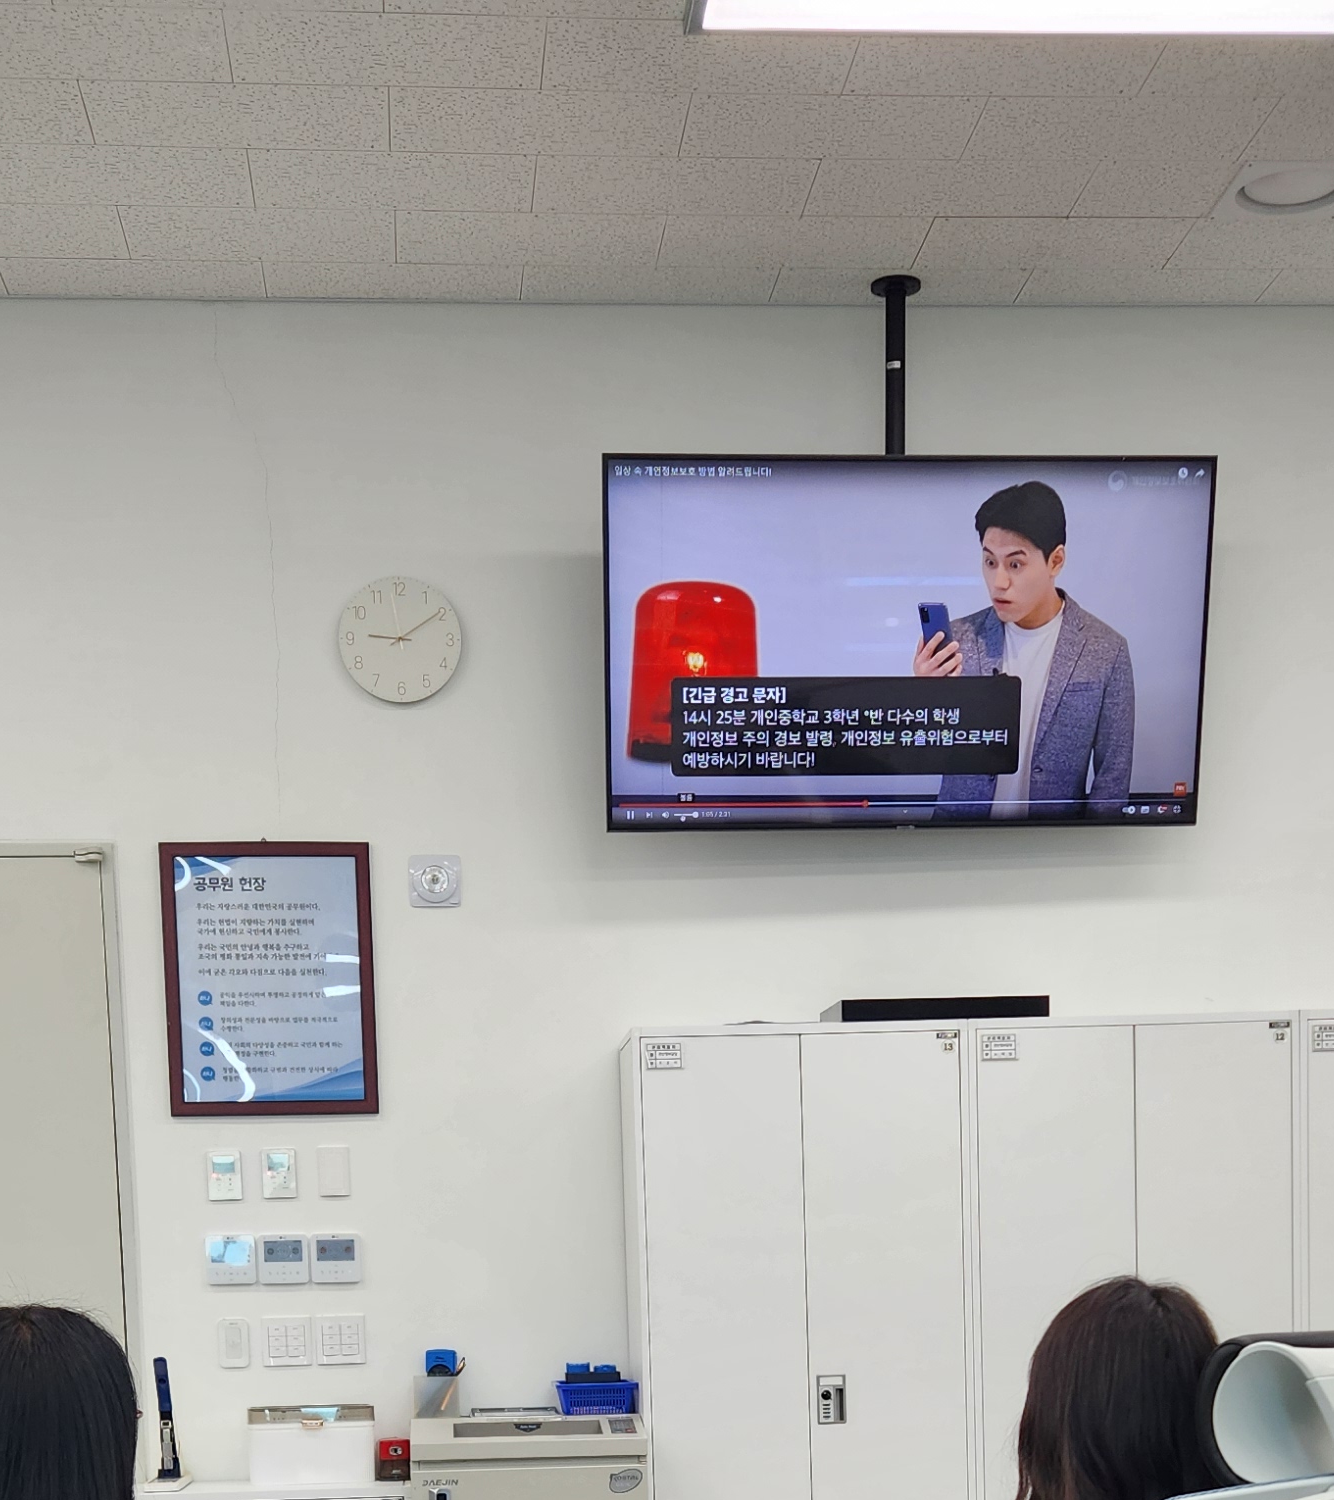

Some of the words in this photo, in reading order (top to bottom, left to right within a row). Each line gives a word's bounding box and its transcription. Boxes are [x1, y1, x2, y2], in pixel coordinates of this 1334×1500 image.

[644, 466, 696, 477] 개인정보보호
[392, 582, 407, 597] 12
[370, 590, 383, 604] 11
[422, 590, 429, 605] 1
[352, 605, 366, 620] 10
[438, 607, 447, 621] 2
[345, 631, 355, 646] 9
[445, 633, 455, 647] 3
[354, 656, 364, 670] 8
[439, 657, 448, 670] 4
[372, 673, 380, 687] 7
[422, 674, 431, 688] 5
[397, 682, 407, 696] 6
[682, 687, 717, 704] [긴급
[720, 687, 749, 703] 경고
[752, 687, 787, 703] 문자]
[683, 710, 712, 725] 14시
[716, 709, 745, 725] 25분
[750, 709, 820, 725] 개인중학교
[823, 709, 860, 725] 3학년
[887, 708, 928, 725] 다수의
[932, 708, 960, 725] 학생
[682, 731, 738, 748] 개인정보
[742, 731, 769, 747] 주의
[774, 730, 801, 747] 경보
[805, 730, 837, 748] 발령,
[840, 730, 895, 747] 개인정보
[899, 730, 1008, 746] 유출위험으로부터
[682, 752, 751, 769] 예방하시기
[756, 751, 815, 768] 바랍니다!
[193, 877, 233, 892] 공무원
[239, 877, 266, 892] 헌장
[1275, 1033, 1285, 1041] 12
[944, 1043, 954, 1051] 13
